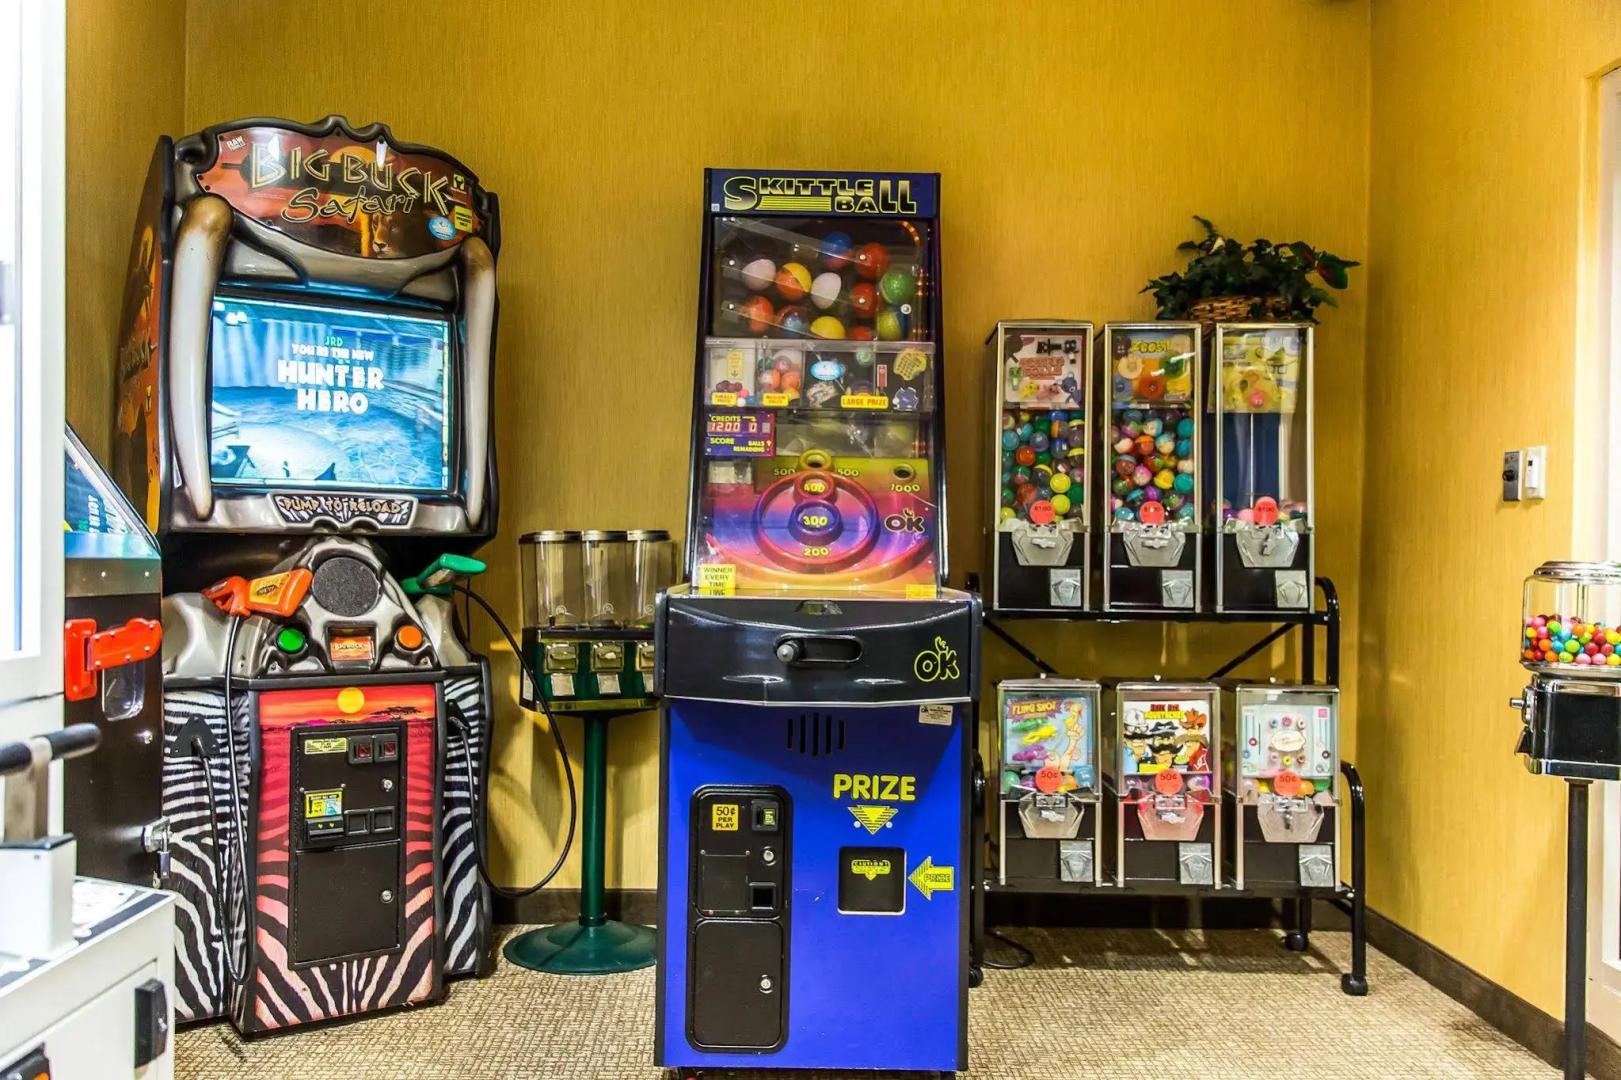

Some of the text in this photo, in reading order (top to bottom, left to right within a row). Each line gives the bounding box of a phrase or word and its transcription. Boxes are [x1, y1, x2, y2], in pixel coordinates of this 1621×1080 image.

[250, 141, 451, 217] BIG BUCK
[723, 176, 874, 211] SKITTLE
[834, 180, 917, 214] BALL
[281, 186, 416, 224] Safari
[325, 336, 344, 347] JRD
[351, 349, 375, 362] NEW
[277, 359, 385, 391] HUNTER
[297, 388, 369, 415] HERO
[842, 397, 888, 406] LARGE PRIZE
[710, 422, 741, 431] 1200
[710, 437, 735, 445] SCORE
[773, 468, 860, 476] 500 500
[890, 483, 921, 493] 1000
[284, 499, 401, 514] PUMP TO RELOAD
[803, 515, 828, 527] 300
[803, 547, 830, 556] 200
[914, 645, 961, 682] OK
[833, 773, 916, 801] PRIZE
[716, 806, 735, 816] 50¢
[923, 873, 951, 882] PRIZE
